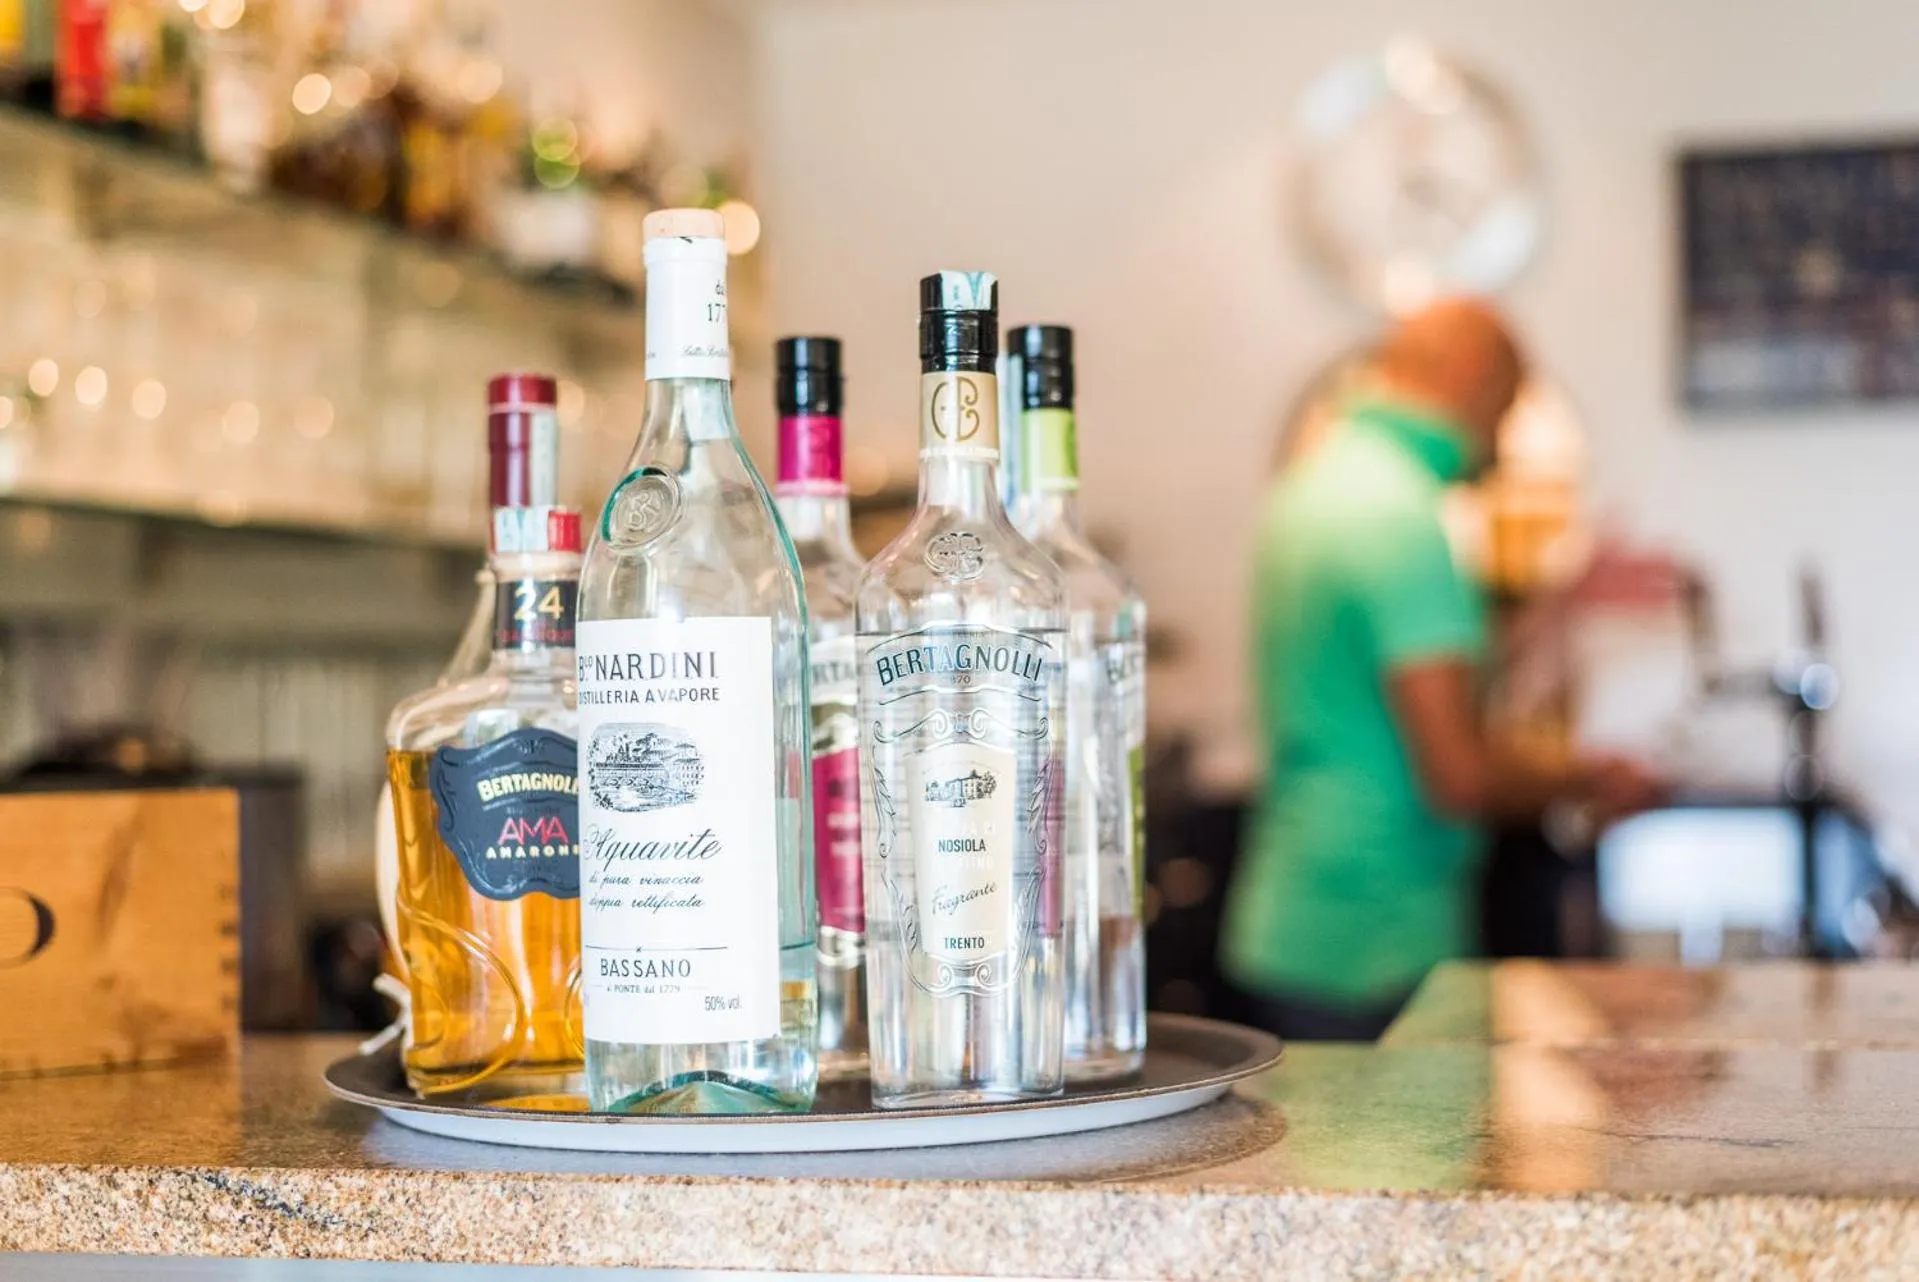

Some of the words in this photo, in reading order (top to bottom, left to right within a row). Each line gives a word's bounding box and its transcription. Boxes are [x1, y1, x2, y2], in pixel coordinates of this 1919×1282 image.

[514, 586, 564, 621] 24
[595, 652, 717, 682] NARDINI
[876, 644, 1043, 686] BERTAGNOLLI
[645, 689, 654, 704] A
[656, 687, 721, 703] VAPORE
[498, 816, 569, 845] AMA
[938, 839, 987, 852] NOSIOLA
[944, 937, 985, 949] TRENTO
[600, 958, 691, 978] BASSANO
[704, 995, 726, 1011] 50%
